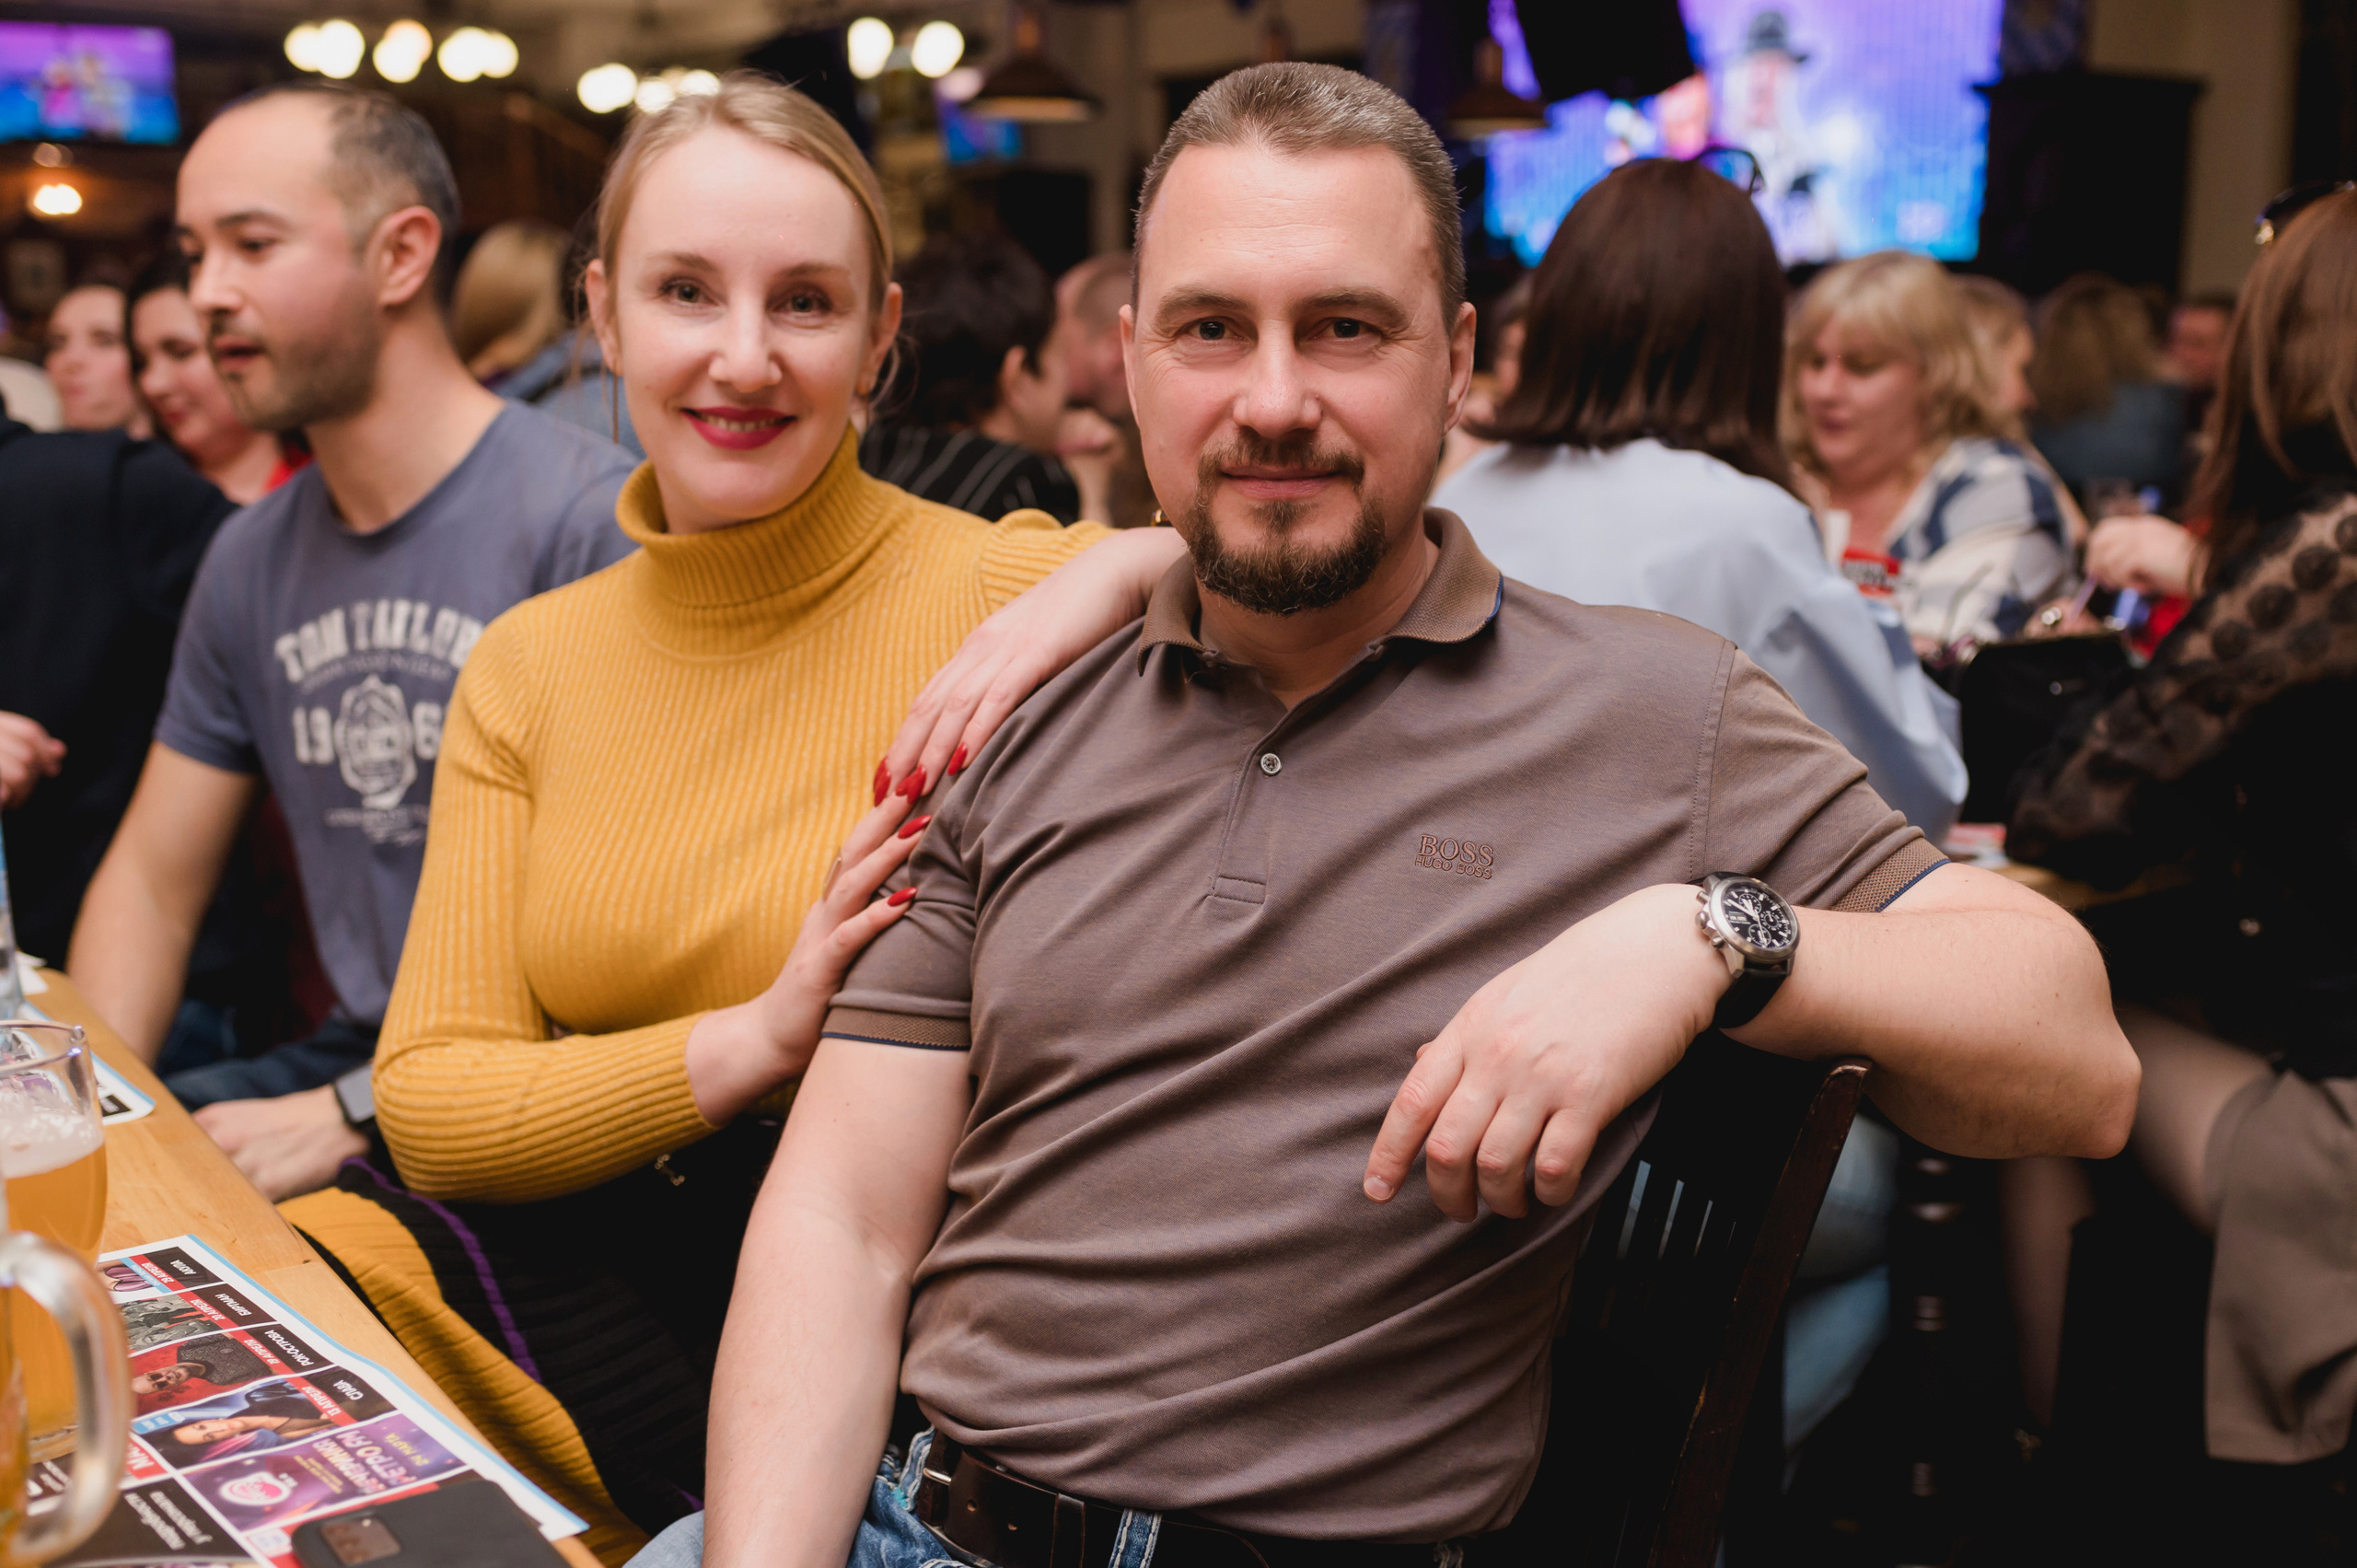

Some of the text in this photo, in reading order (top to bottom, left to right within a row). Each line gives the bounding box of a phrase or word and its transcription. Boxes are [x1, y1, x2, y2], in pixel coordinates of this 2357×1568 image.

[1418, 833, 1493, 866] BOSS
[1415, 856, 1492, 879] HUGO BOSS
[190, 1298, 220, 1316] АПРЕЛЯ
[215, 1293, 253, 1317] БИРТМАН
[243, 1338, 275, 1360] АПРЕЛЯ
[264, 1330, 315, 1367] РОК-ОСТРОВА
[301, 1385, 343, 1417] 13 АПРЕЛЯ
[332, 1379, 365, 1400] СЛАВА
[384, 1432, 417, 1457] МАРТА
[312, 1438, 388, 1494] ВЕЧЕРИНКА
[355, 1446, 418, 1486] РЕТРО
